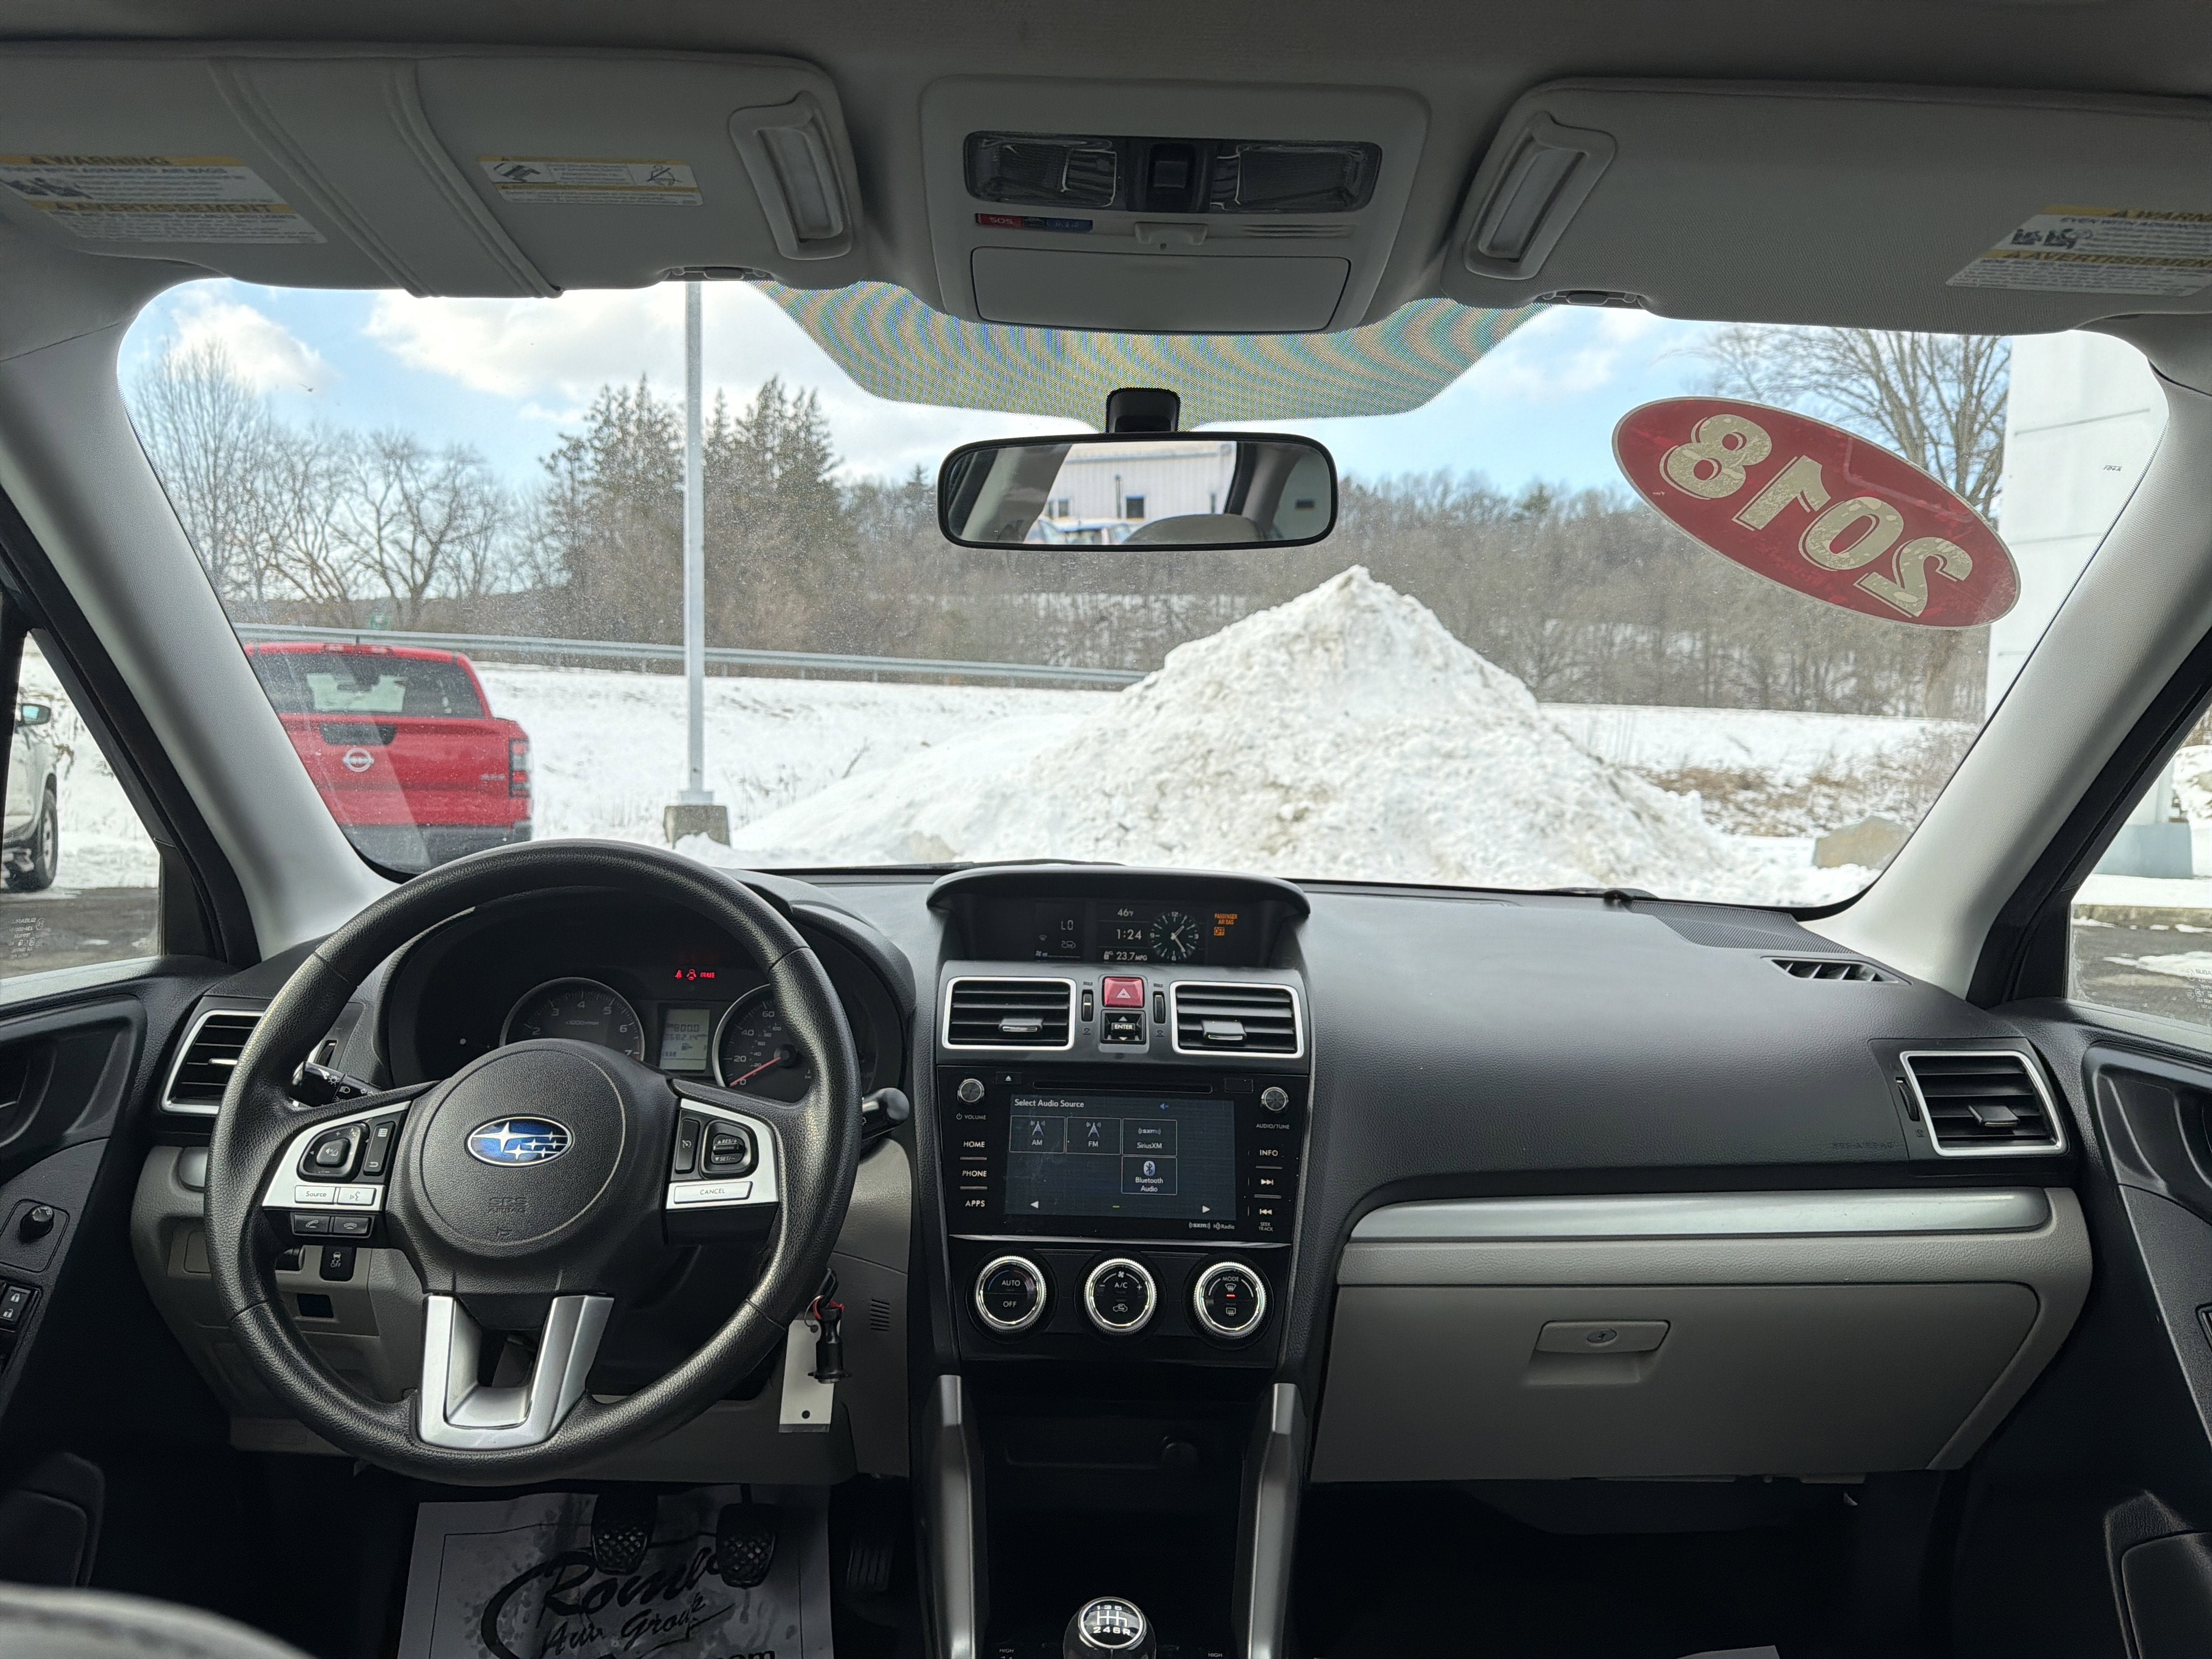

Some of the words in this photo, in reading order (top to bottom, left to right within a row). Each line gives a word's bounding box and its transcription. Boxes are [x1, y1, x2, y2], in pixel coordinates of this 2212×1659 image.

[1116, 929, 1142, 940] 1:24
[1116, 951, 1135, 961] 23.7
[551, 1008, 560, 1016] 3
[603, 1006, 612, 1015] 5
[532, 1026, 541, 1036] 2
[619, 1024, 628, 1033] 6
[1014, 1098, 1036, 1107] Select
[1060, 1099, 1085, 1108] Source
